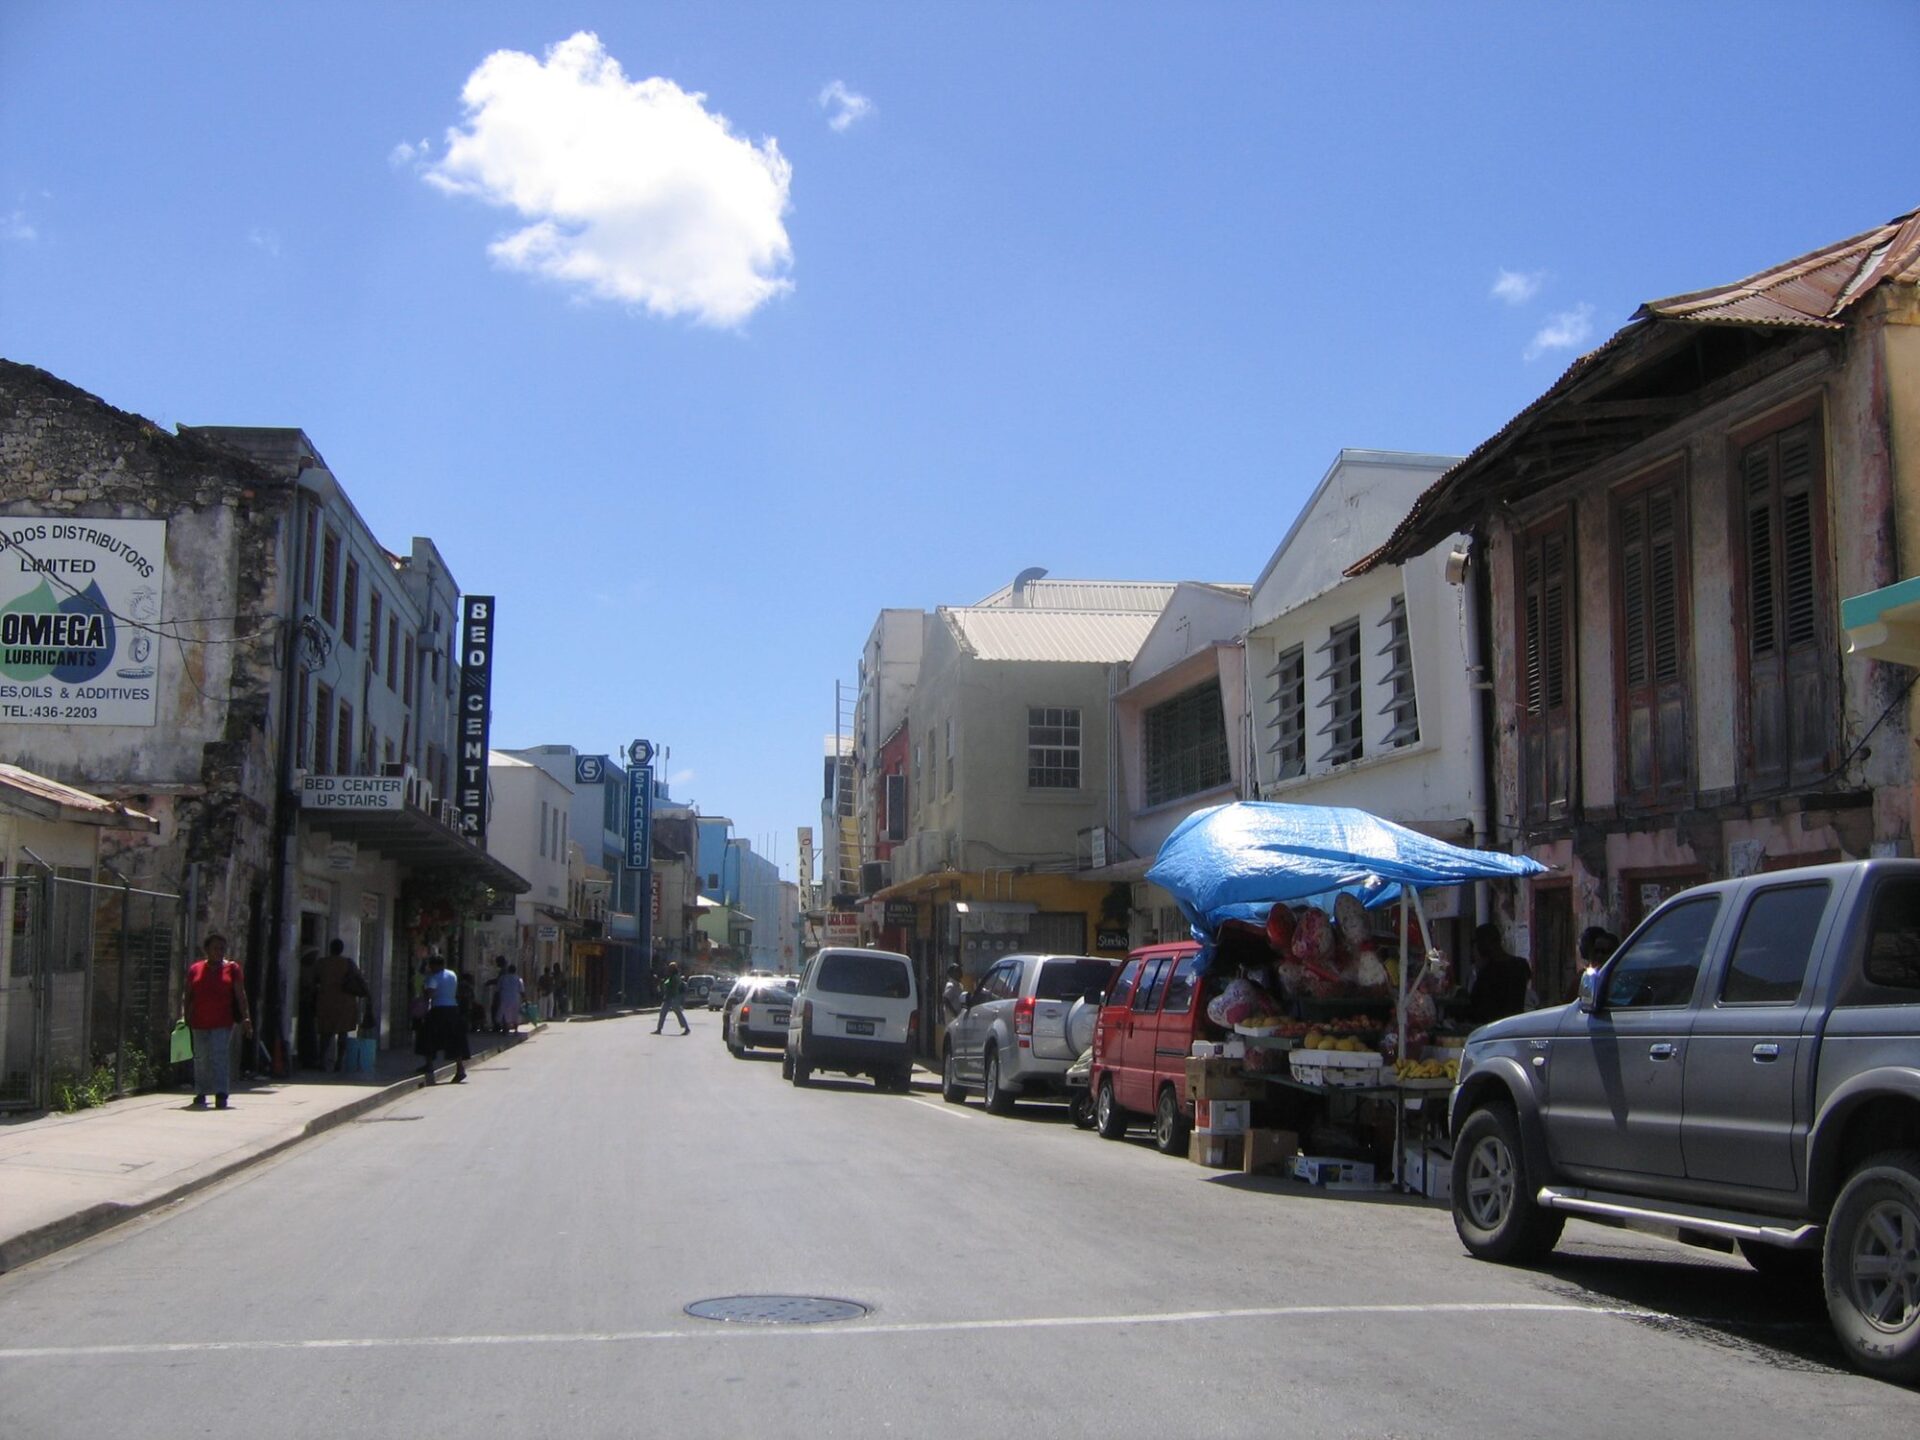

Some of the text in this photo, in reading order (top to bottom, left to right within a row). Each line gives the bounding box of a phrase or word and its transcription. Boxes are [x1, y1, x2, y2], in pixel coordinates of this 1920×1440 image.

[52, 525, 154, 578] DISTRIBUTORS
[20, 559, 96, 573] LIMITED
[1, 613, 105, 647] OMEGA
[5, 650, 97, 667] LUBRICANTS
[60, 688, 70, 699] &
[75, 688, 150, 700] ADDITIVES
[2, 705, 98, 718] TEL:436-2203
[463, 602, 488, 831] BED CENTER
[304, 778, 401, 792] BED CENTER
[316, 795, 388, 807] UPSTAIRS
[633, 771, 645, 866] STANDARD
